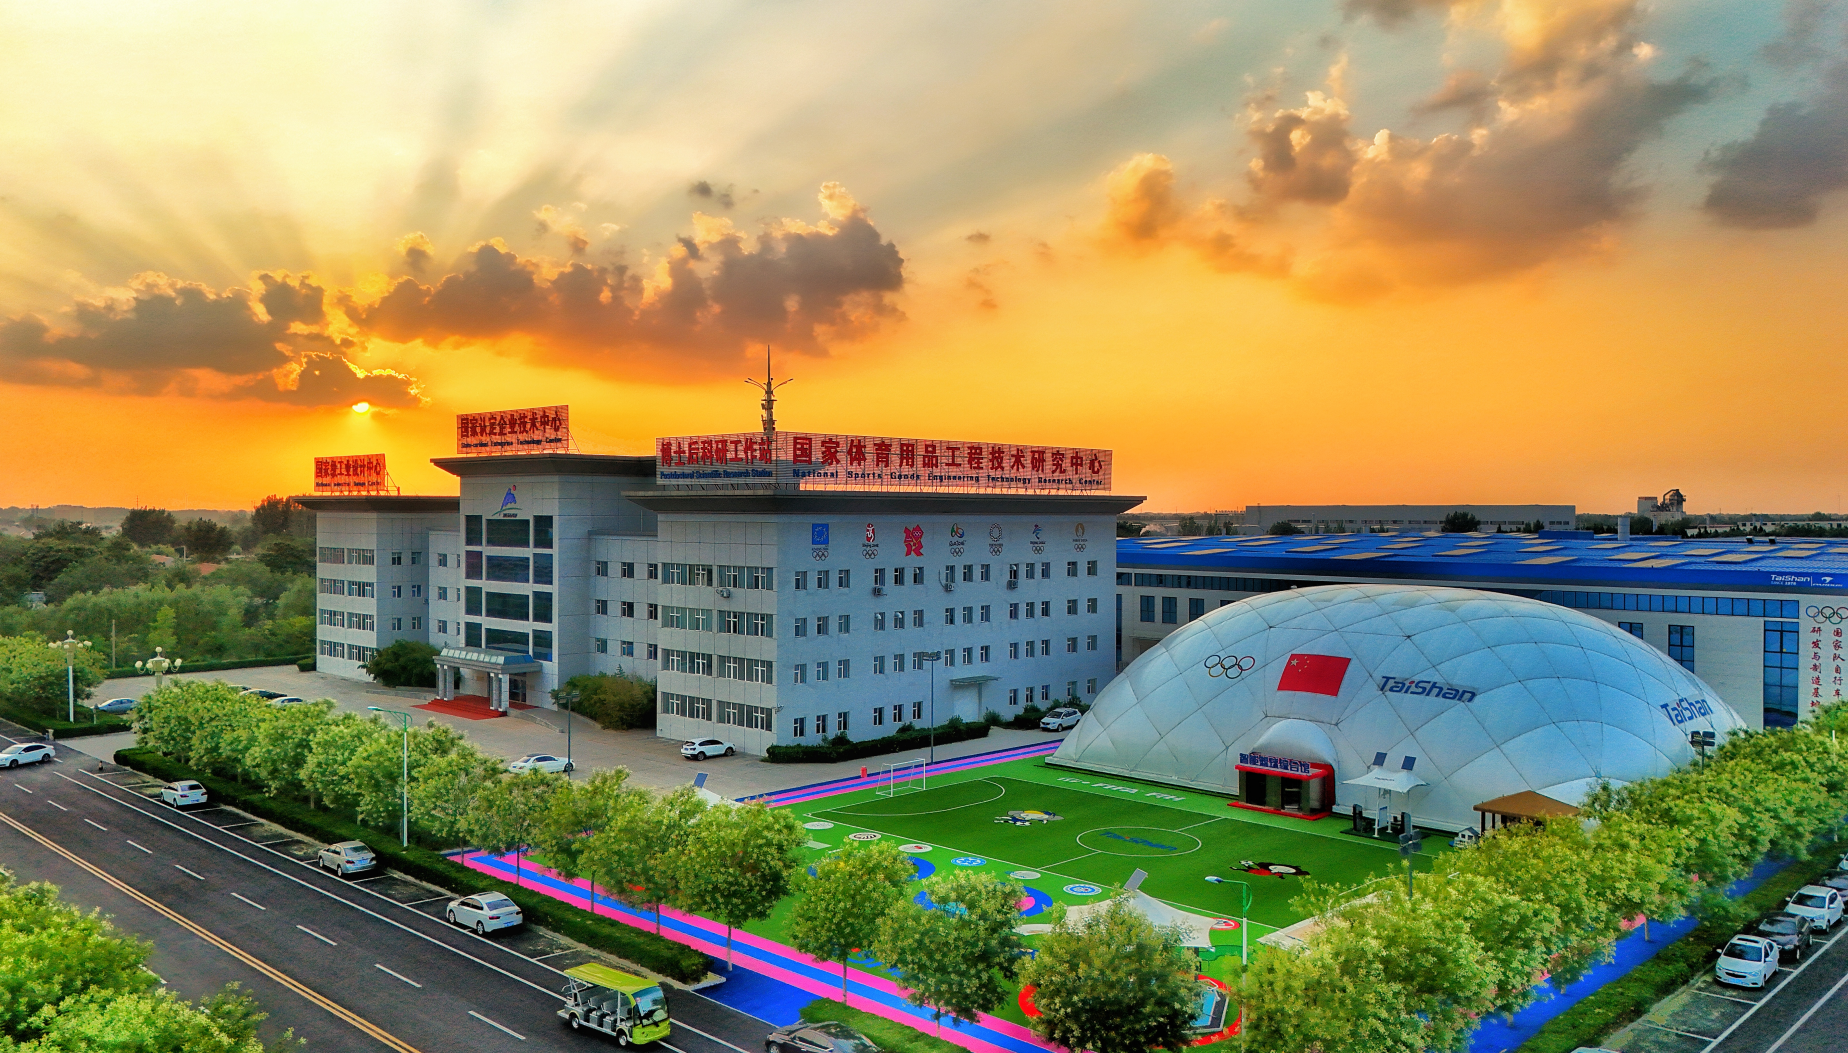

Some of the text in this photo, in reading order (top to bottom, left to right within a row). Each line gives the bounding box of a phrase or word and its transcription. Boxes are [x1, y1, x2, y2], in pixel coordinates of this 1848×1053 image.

[461, 410, 562, 438] 国家认定企业技术中心
[660, 436, 772, 467] 博士后科研工作站
[793, 437, 1103, 475] 国家体育用品工程技术研究中心
[316, 458, 382, 478] 国家级工业设计中心
[660, 468, 773, 479] Postdoctoral Scientific Research Station
[792, 469, 1103, 486] National Sports Goods Engineering Technology Research Center
[1770, 574, 1811, 582] TaiShan
[1832, 628, 1845, 700] 国家队自行车
[1380, 676, 1477, 703] TaiShan
[1660, 697, 1714, 726] TaiShan
